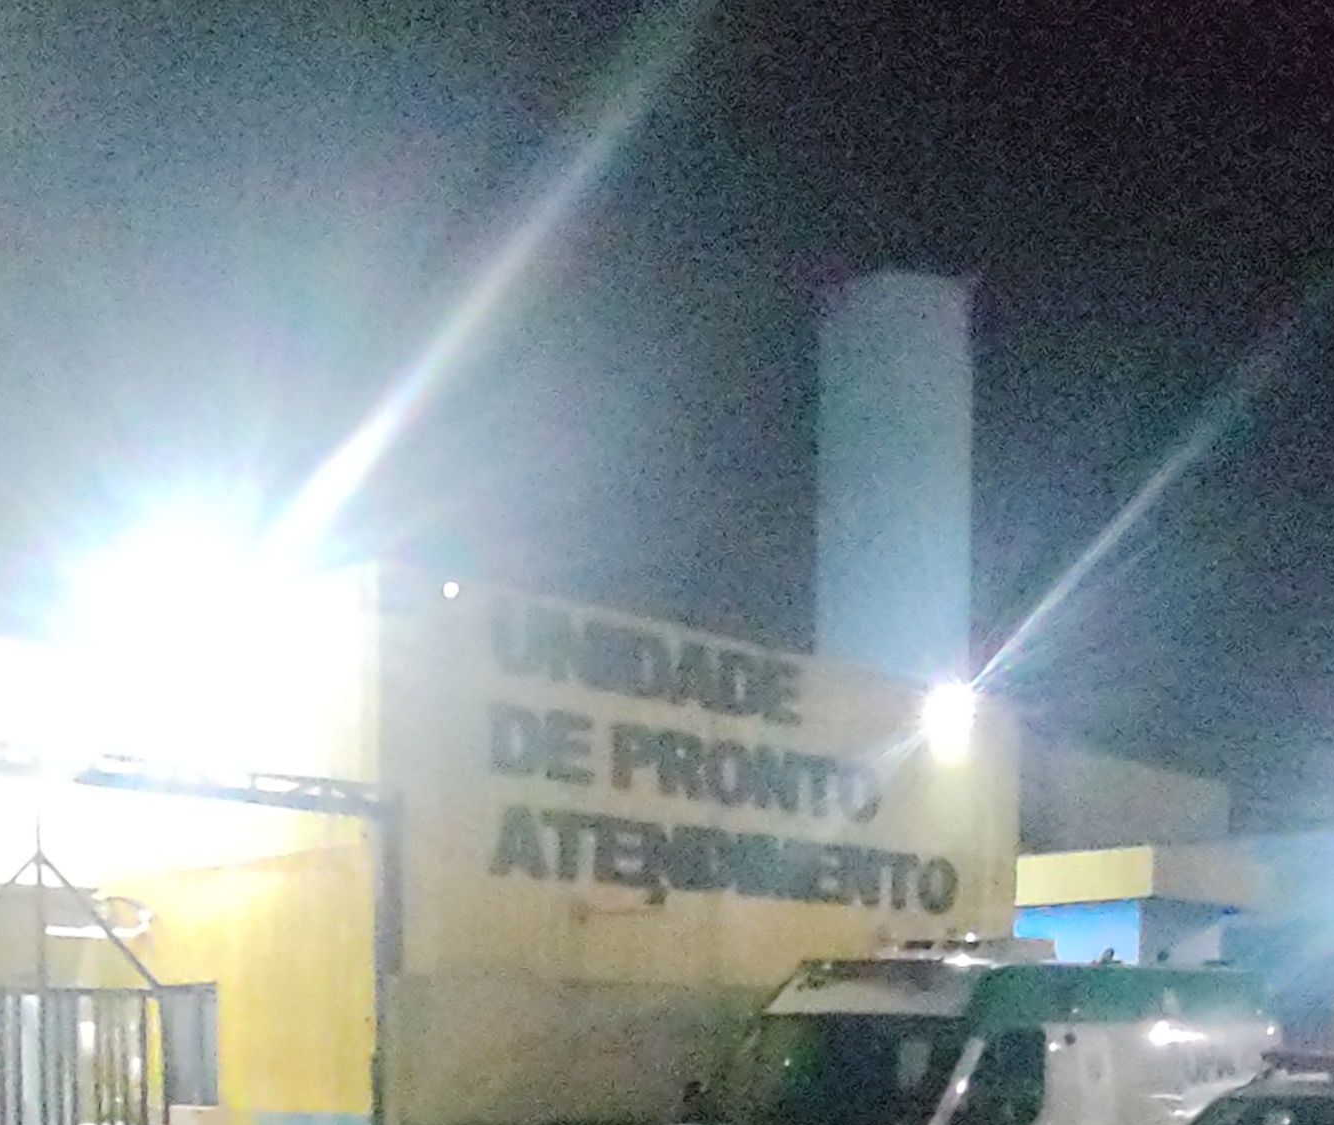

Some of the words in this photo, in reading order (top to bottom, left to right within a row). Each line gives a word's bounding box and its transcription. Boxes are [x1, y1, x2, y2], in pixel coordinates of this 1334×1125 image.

[489, 594, 803, 727] UNIDADE
[489, 702, 595, 786] DE
[610, 722, 881, 824] PRONTO
[487, 803, 960, 916] ATENDIMENTO
